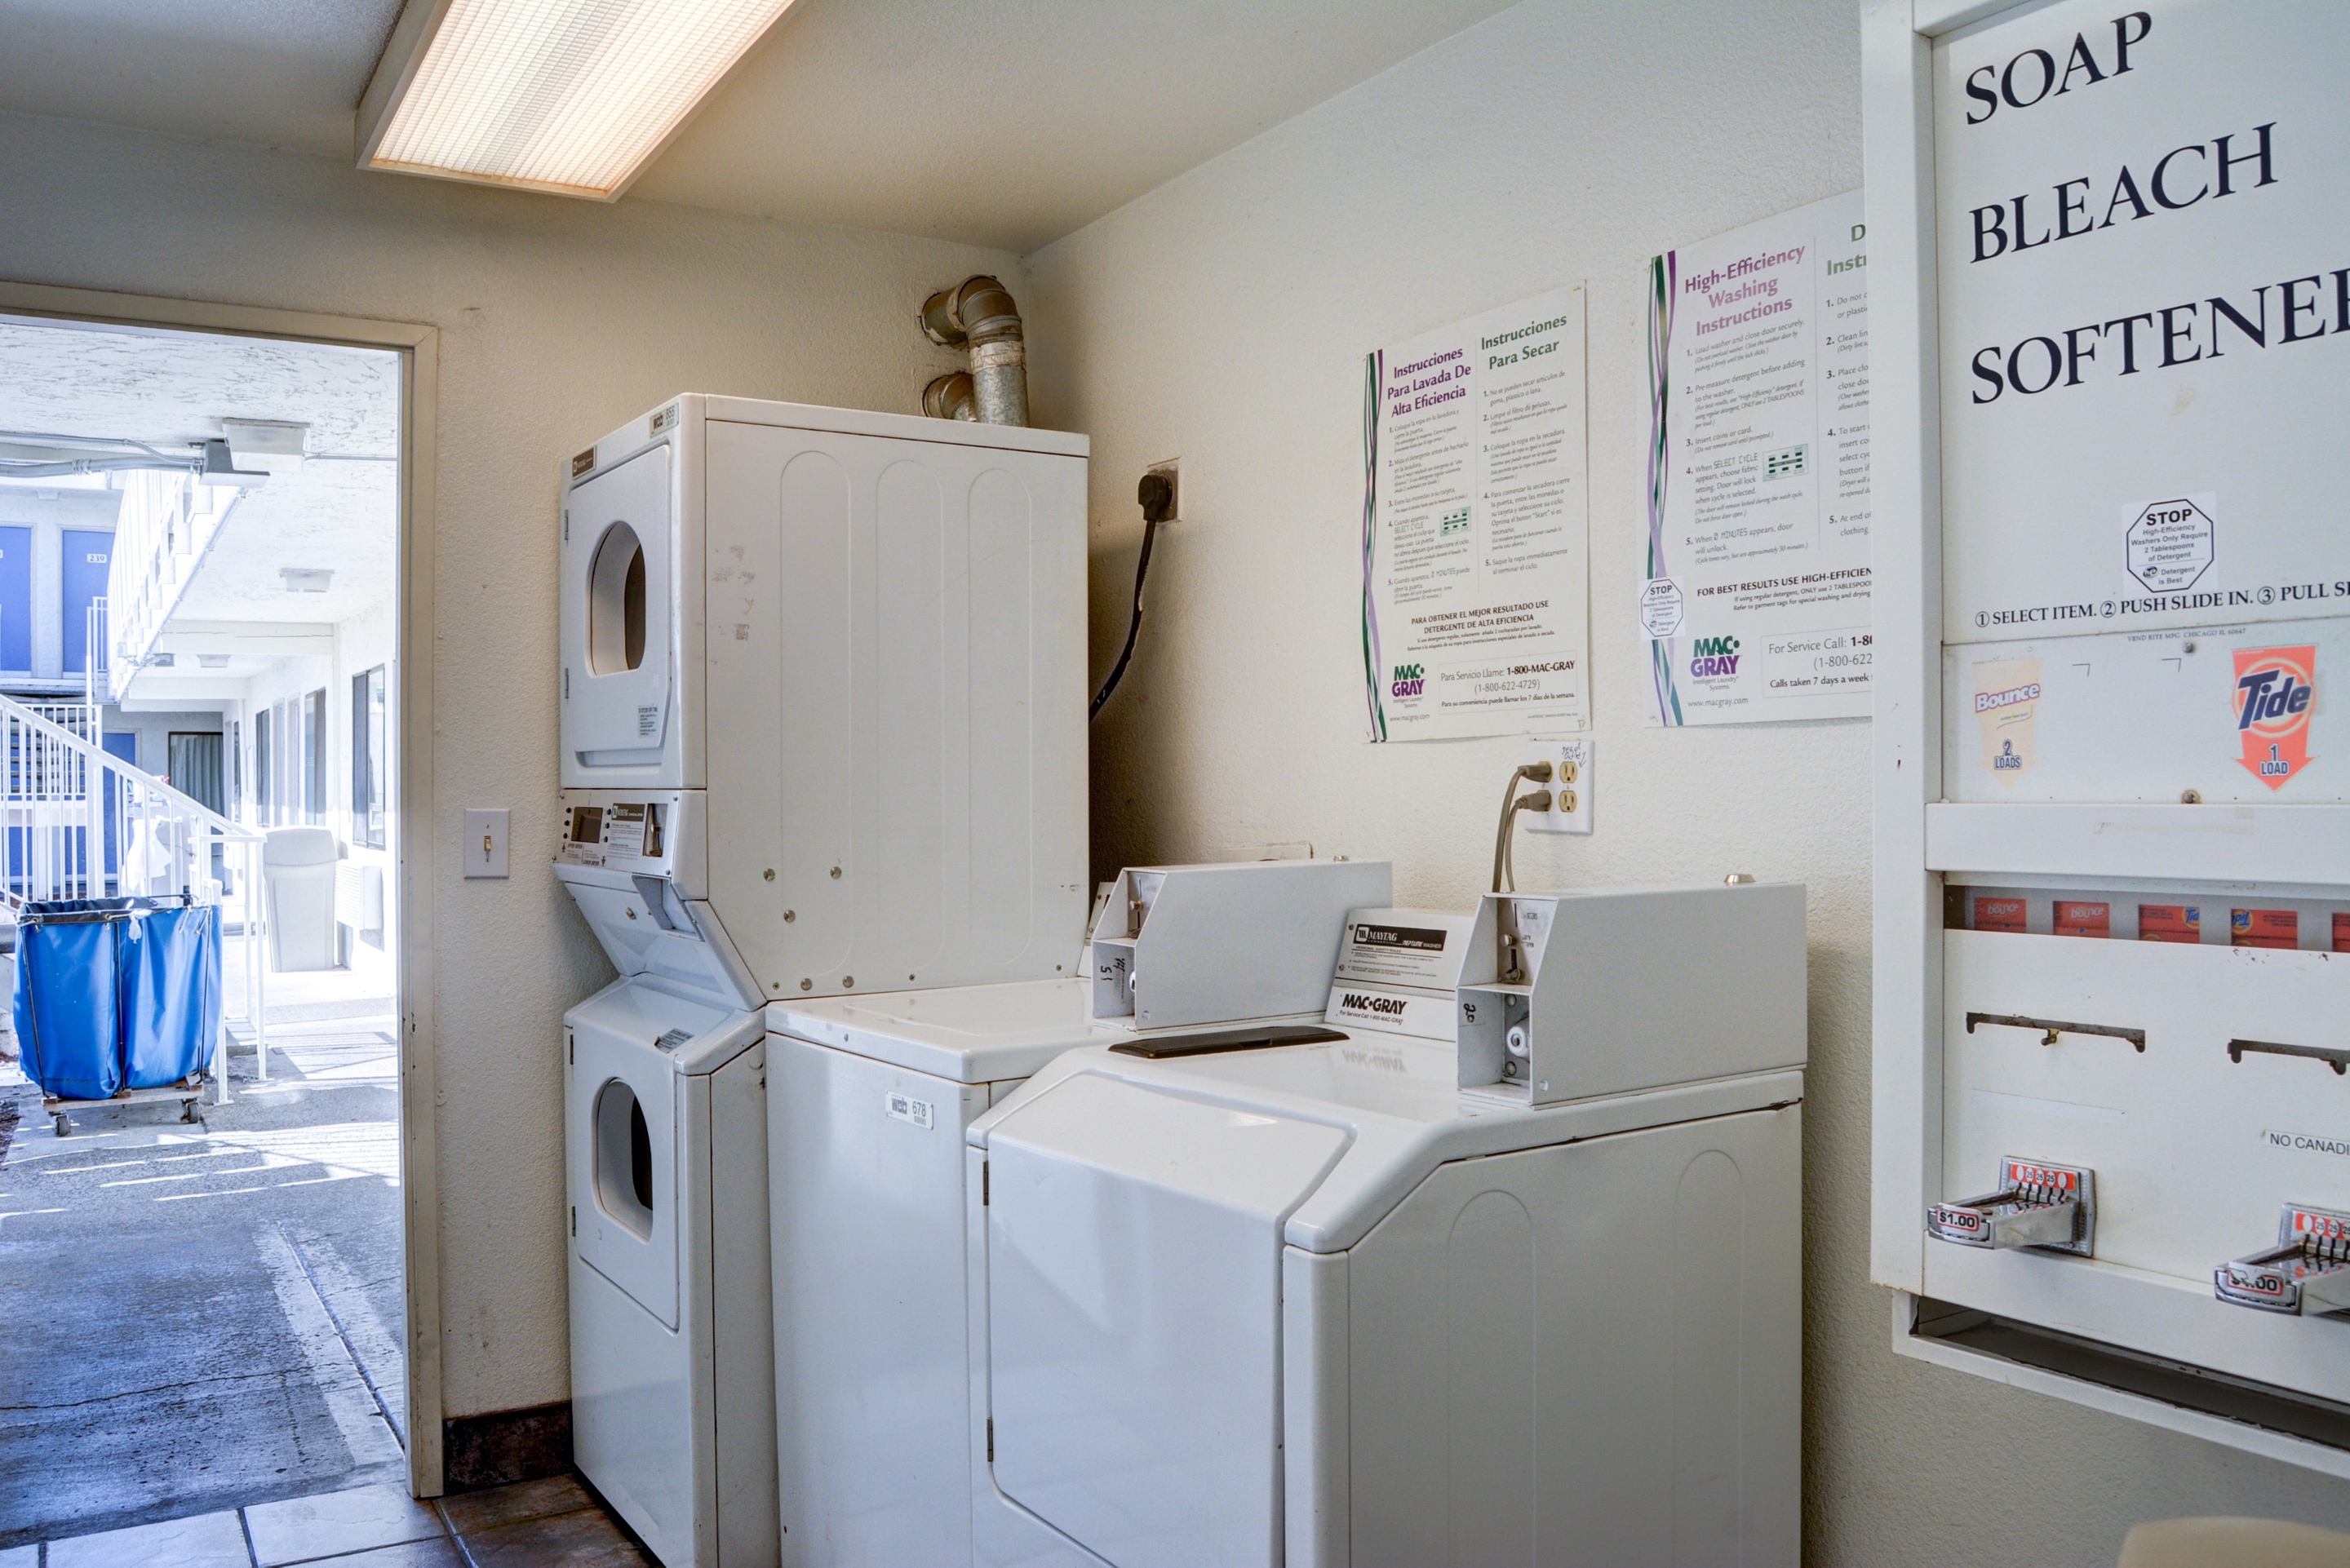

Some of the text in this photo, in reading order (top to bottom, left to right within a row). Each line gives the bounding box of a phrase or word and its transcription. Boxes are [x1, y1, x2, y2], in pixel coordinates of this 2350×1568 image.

[1965, 11, 2152, 125] SOAP
[1968, 122, 2278, 264] BLEACH
[1686, 246, 1805, 294] High-Efficiency
[1709, 278, 1778, 308] Washing
[1696, 299, 1792, 335] Instructions
[1482, 317, 1567, 350] Instrucciones
[1696, 346, 1709, 354] Load
[1710, 339, 1731, 350] washer
[1732, 335, 1743, 343] and
[1745, 332, 1760, 340] close
[1762, 326, 1776, 335] door
[1778, 318, 1805, 331] securely.
[1394, 348, 1462, 379] Instrucciones
[1489, 341, 1559, 370] Para Secar
[1388, 365, 1470, 400] Para Lavada De
[1696, 379, 1730, 392] Pre-measure
[1731, 370, 1759, 383] detergent
[1761, 363, 1780, 374] before
[1782, 360, 1805, 369] adding
[1391, 385, 1465, 418] Alta Eficiencia
[2146, 509, 2192, 525] STOP
[2143, 525, 2195, 536] High-Efficiency
[2131, 538, 2161, 546] Washers
[2151, 543, 2194, 553] Tablespoons
[2157, 551, 2191, 560] Detergent
[2162, 567, 2195, 575] Detergent
[1651, 585, 1672, 595] STOP
[1697, 588, 1714, 596] FOR
[1718, 584, 1738, 594] BEST
[1741, 579, 1779, 591] RESULTS
[1782, 577, 1798, 586] USE
[1754, 592, 1771, 600] regular
[1755, 601, 1775, 610] garment
[1798, 596, 1816, 605] special
[1818, 594, 1839, 603] washing
[1853, 591, 1870, 599] drying
[1993, 608, 2049, 625] SELECT
[2052, 604, 2096, 619] ITEM.
[2121, 597, 2166, 614] PUSH
[2171, 592, 2223, 610] SLIDE
[2229, 591, 2253, 605] IN.
[2281, 583, 2329, 601] PULL
[1428, 613, 1457, 622] OBTENER
[1469, 609, 1491, 618] MEJOR
[1493, 603, 1533, 613] RESULTADO
[1425, 622, 1465, 633] DETERGENTE
[1478, 618, 1494, 627] ALTA
[1496, 614, 1534, 625] EFICIENCIA
[1769, 644, 1785, 653] For
[1787, 640, 1820, 653] Service
[1824, 637, 1847, 649] Call:
[1441, 661, 1575, 681] Para Servicio Llame: 1-800-MAC-GRAY
[1691, 655, 1740, 677] GRAY
[1392, 679, 1425, 697] GRAY
[1474, 679, 1540, 695] (1-800-622-4729)
[1770, 680, 1787, 688] Calls
[1790, 678, 1811, 686] taken
[1821, 676, 1838, 686] days
[1848, 673, 1869, 682] week
[1687, 698, 1748, 708] www.macgray.com
[1975, 684, 2040, 713] Bounce
[2238, 670, 2312, 730] Tide
[1390, 714, 1430, 722] www.macgray.com
[2004, 741, 2011, 756] 2
[2270, 745, 2277, 761] 1
[1995, 757, 2020, 768] LOADS
[2261, 762, 2288, 775] LOAD
[1368, 932, 1397, 941] MAYTAG
[1370, 1015, 1403, 1024] 1-800-MAC-GRAY
[892, 1097, 926, 1117] web 678
[2270, 1134, 2291, 1146] NO
[1940, 1211, 1975, 1228] $1.00
[2317, 1221, 2325, 1230] 25
[2330, 1224, 2338, 1233] 25
